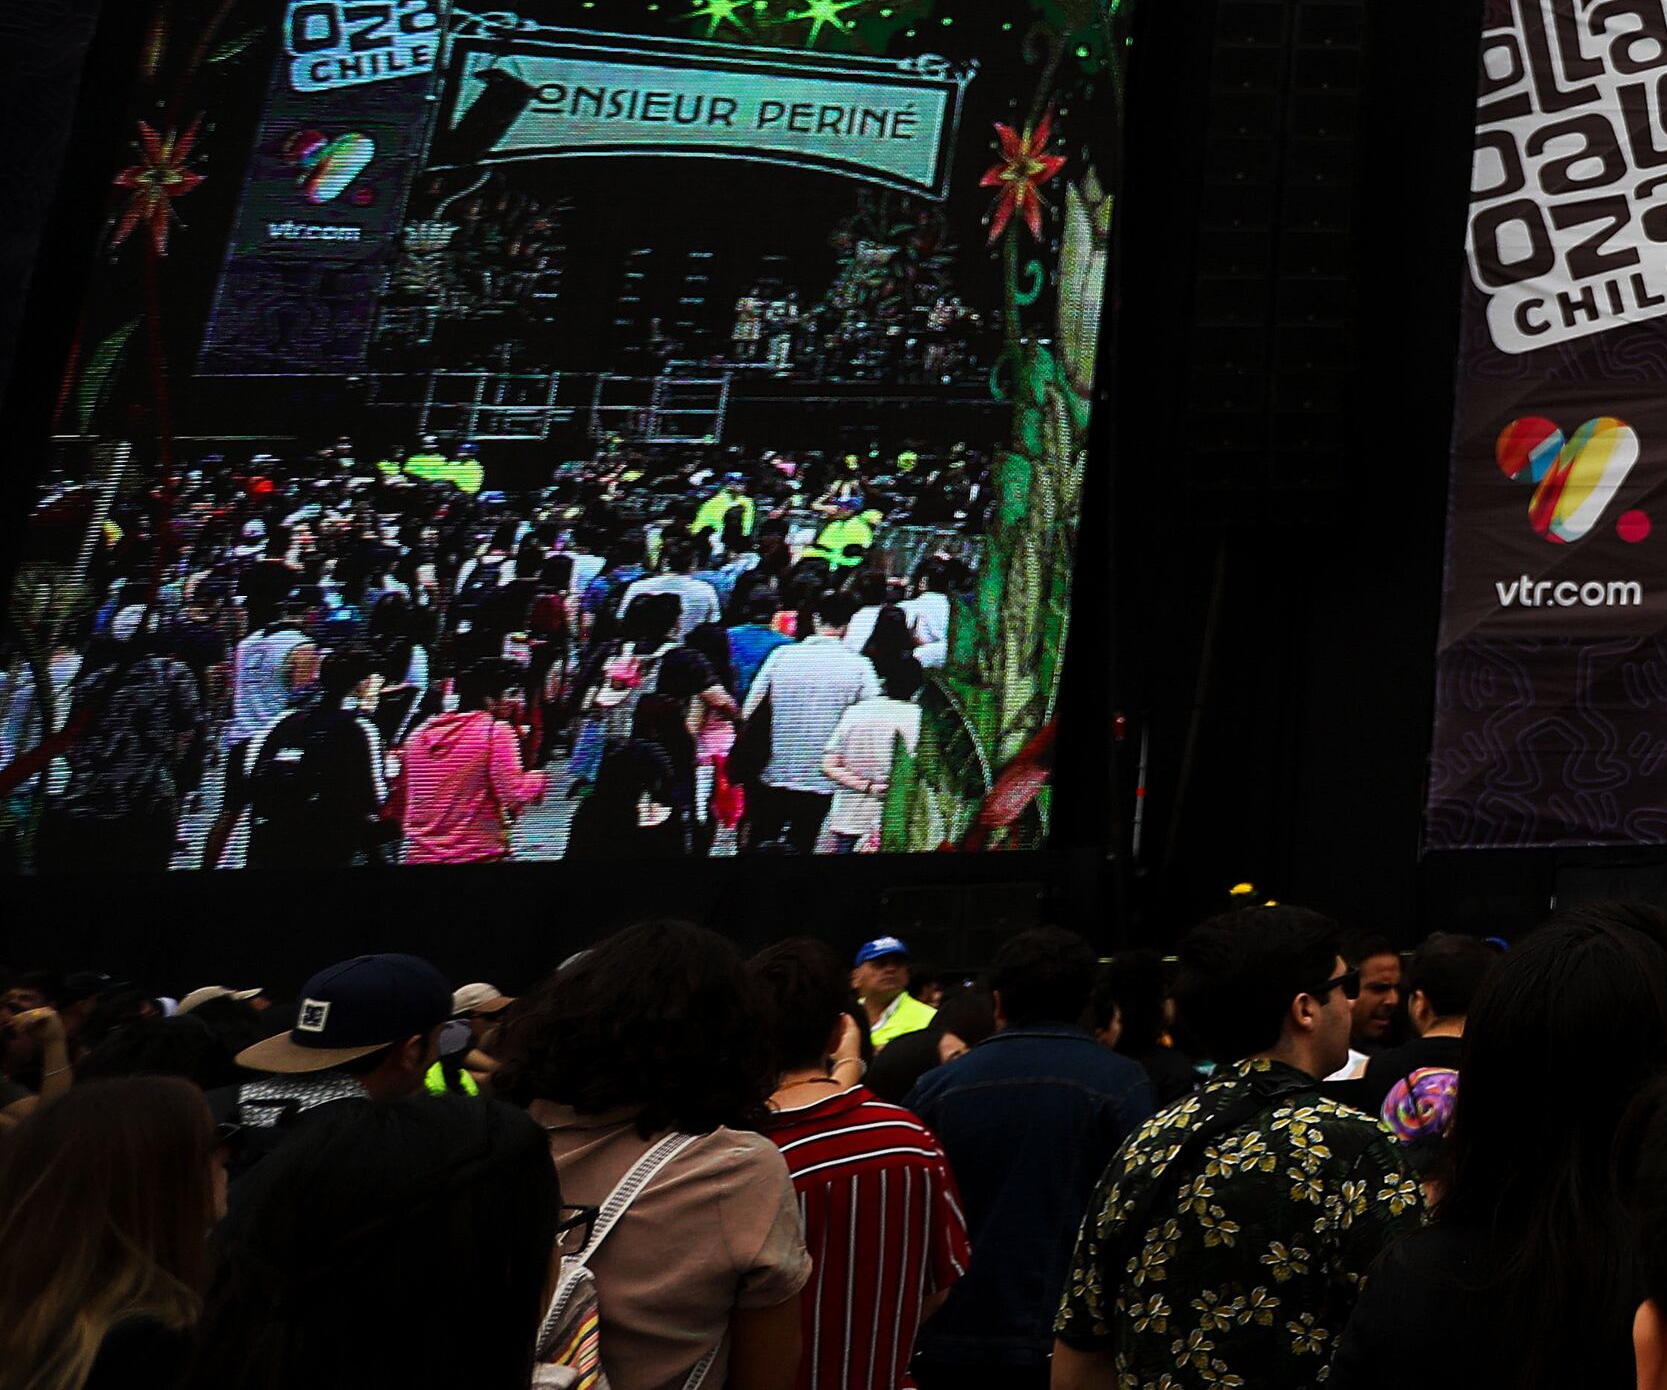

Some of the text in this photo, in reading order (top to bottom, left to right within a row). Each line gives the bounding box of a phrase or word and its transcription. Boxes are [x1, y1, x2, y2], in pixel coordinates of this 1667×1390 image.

[532, 82, 920, 141] ONSIEUR PERINÉ
[1495, 574, 1643, 607] vtr.com
